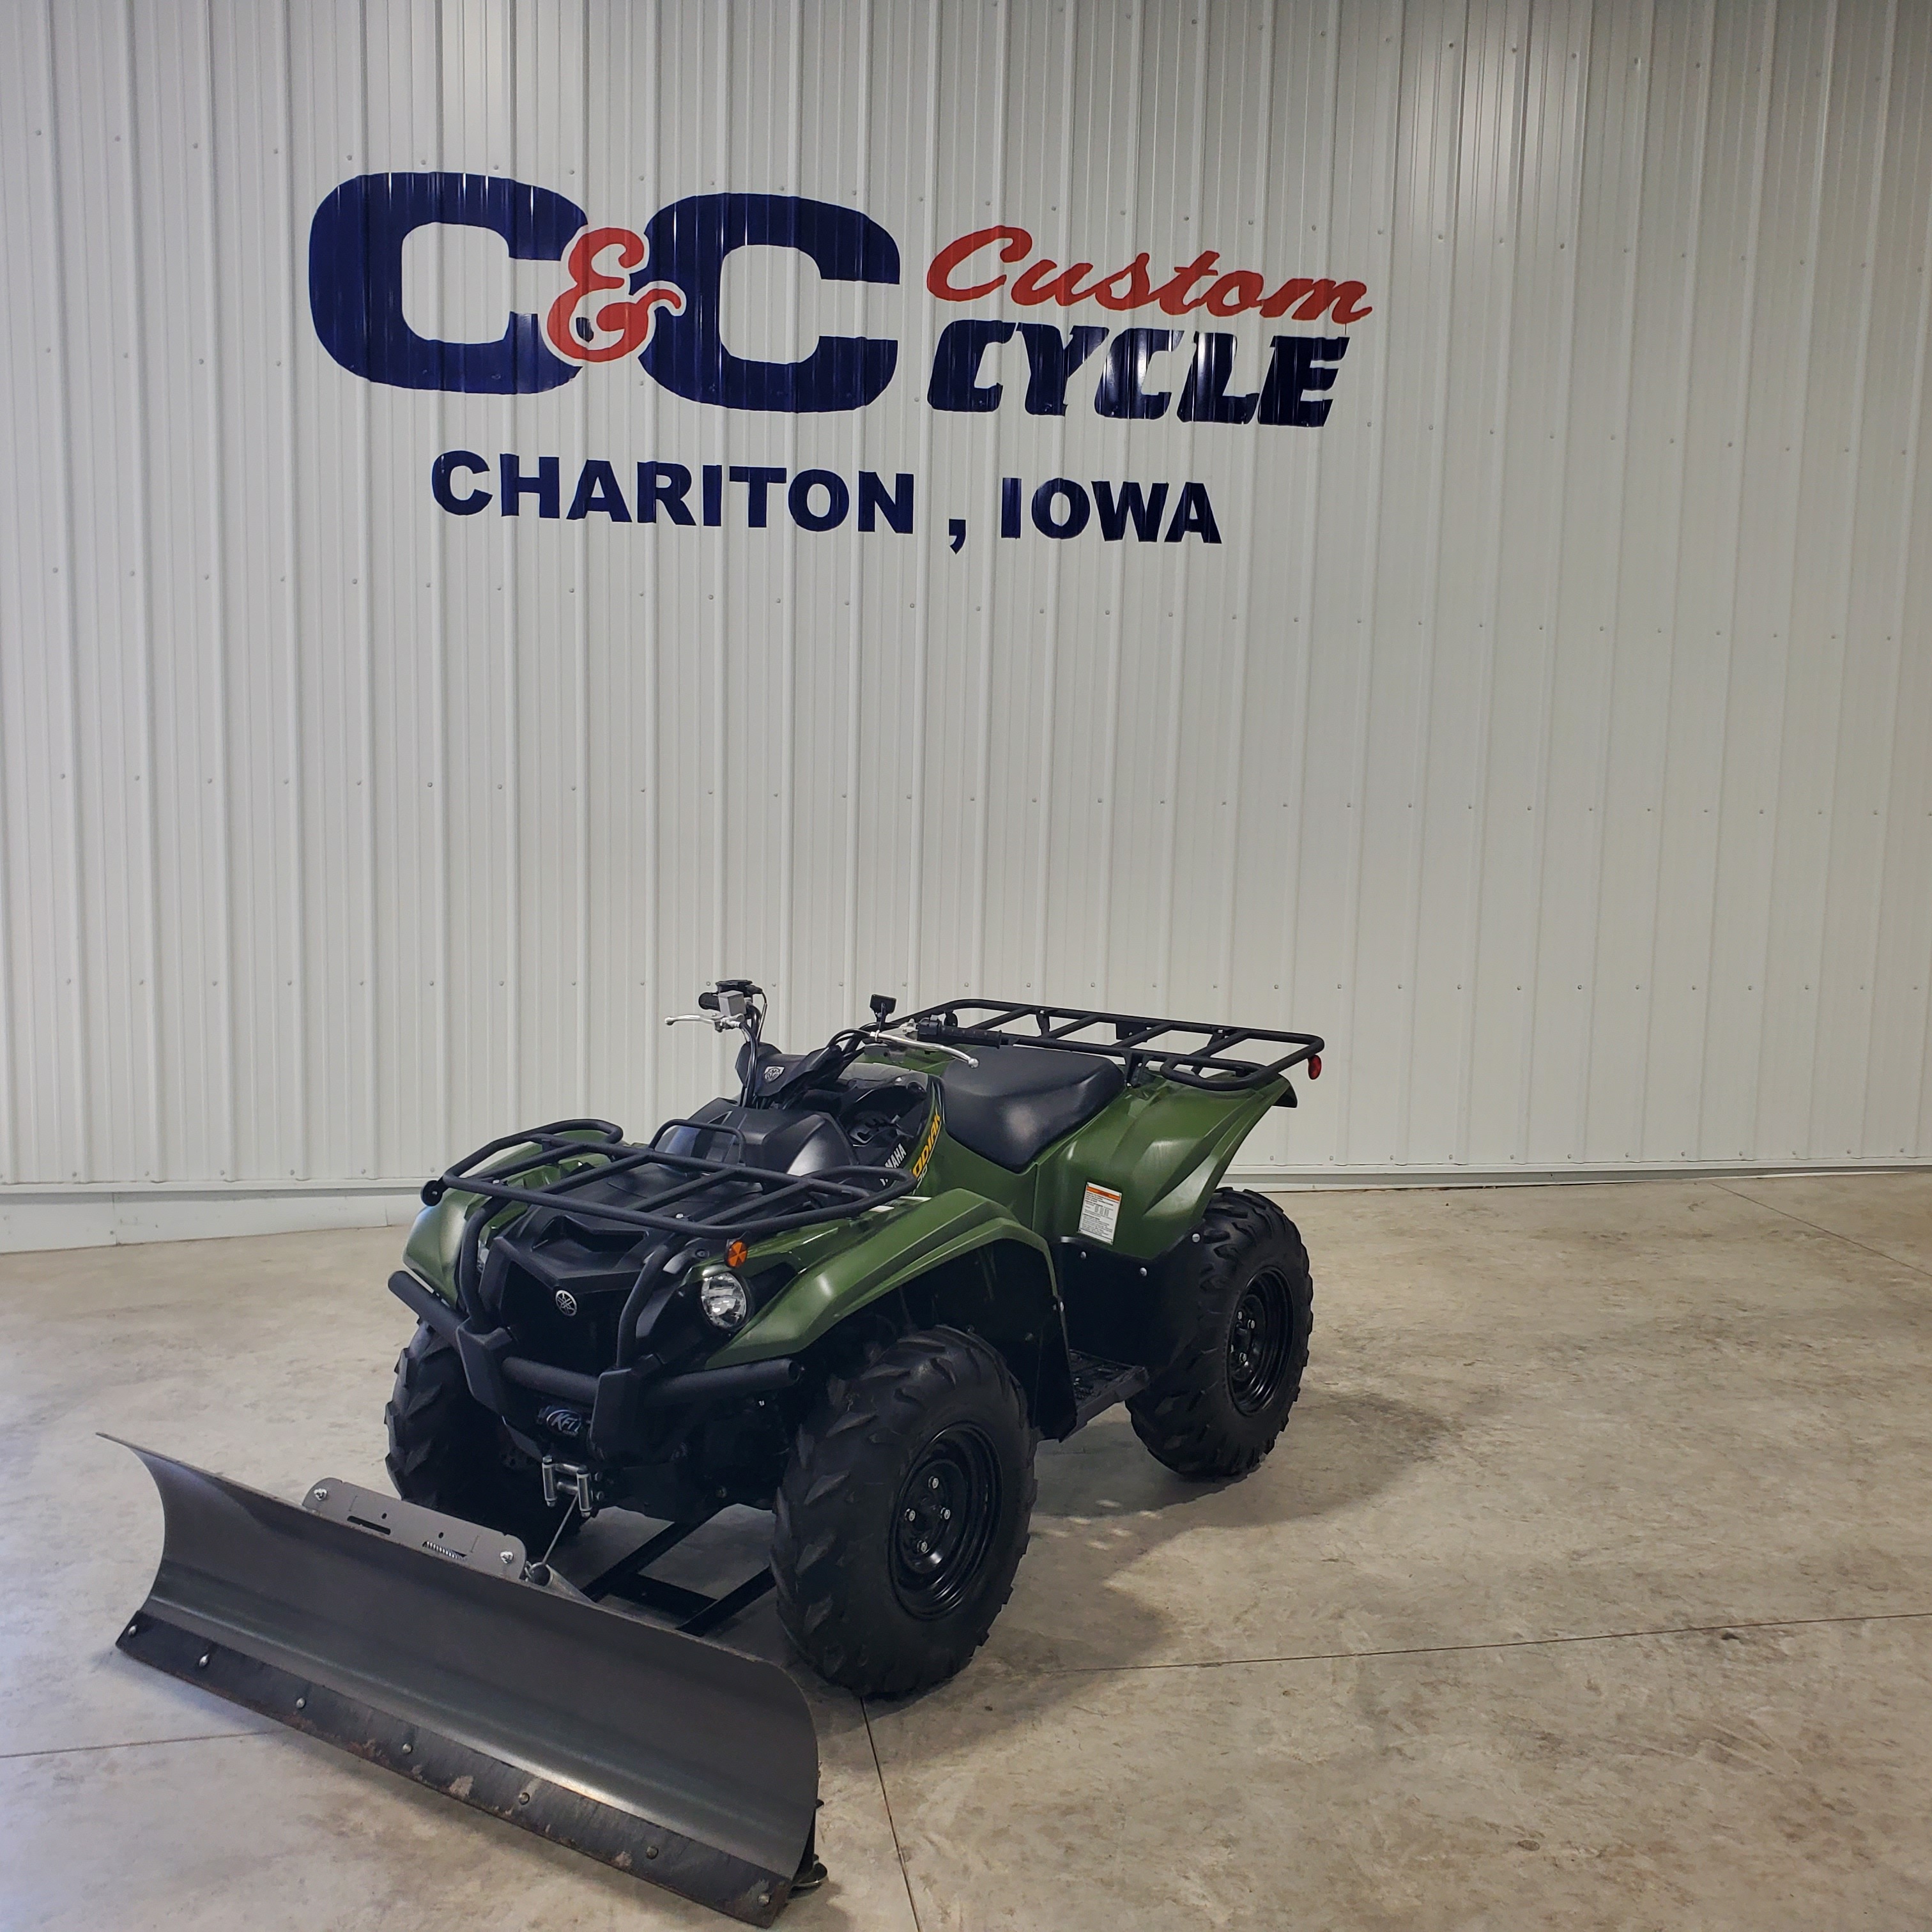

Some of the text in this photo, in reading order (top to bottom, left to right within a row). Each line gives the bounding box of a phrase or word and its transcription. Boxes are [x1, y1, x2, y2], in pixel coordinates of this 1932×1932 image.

[309, 171, 901, 414] C&C
[926, 225, 1373, 325] Custom
[927, 319, 1350, 427] CYCLE
[431, 450, 914, 535] CHARITON
[1000, 477, 1222, 544] IOWA
[912, 1114, 941, 1179] ODIAK
